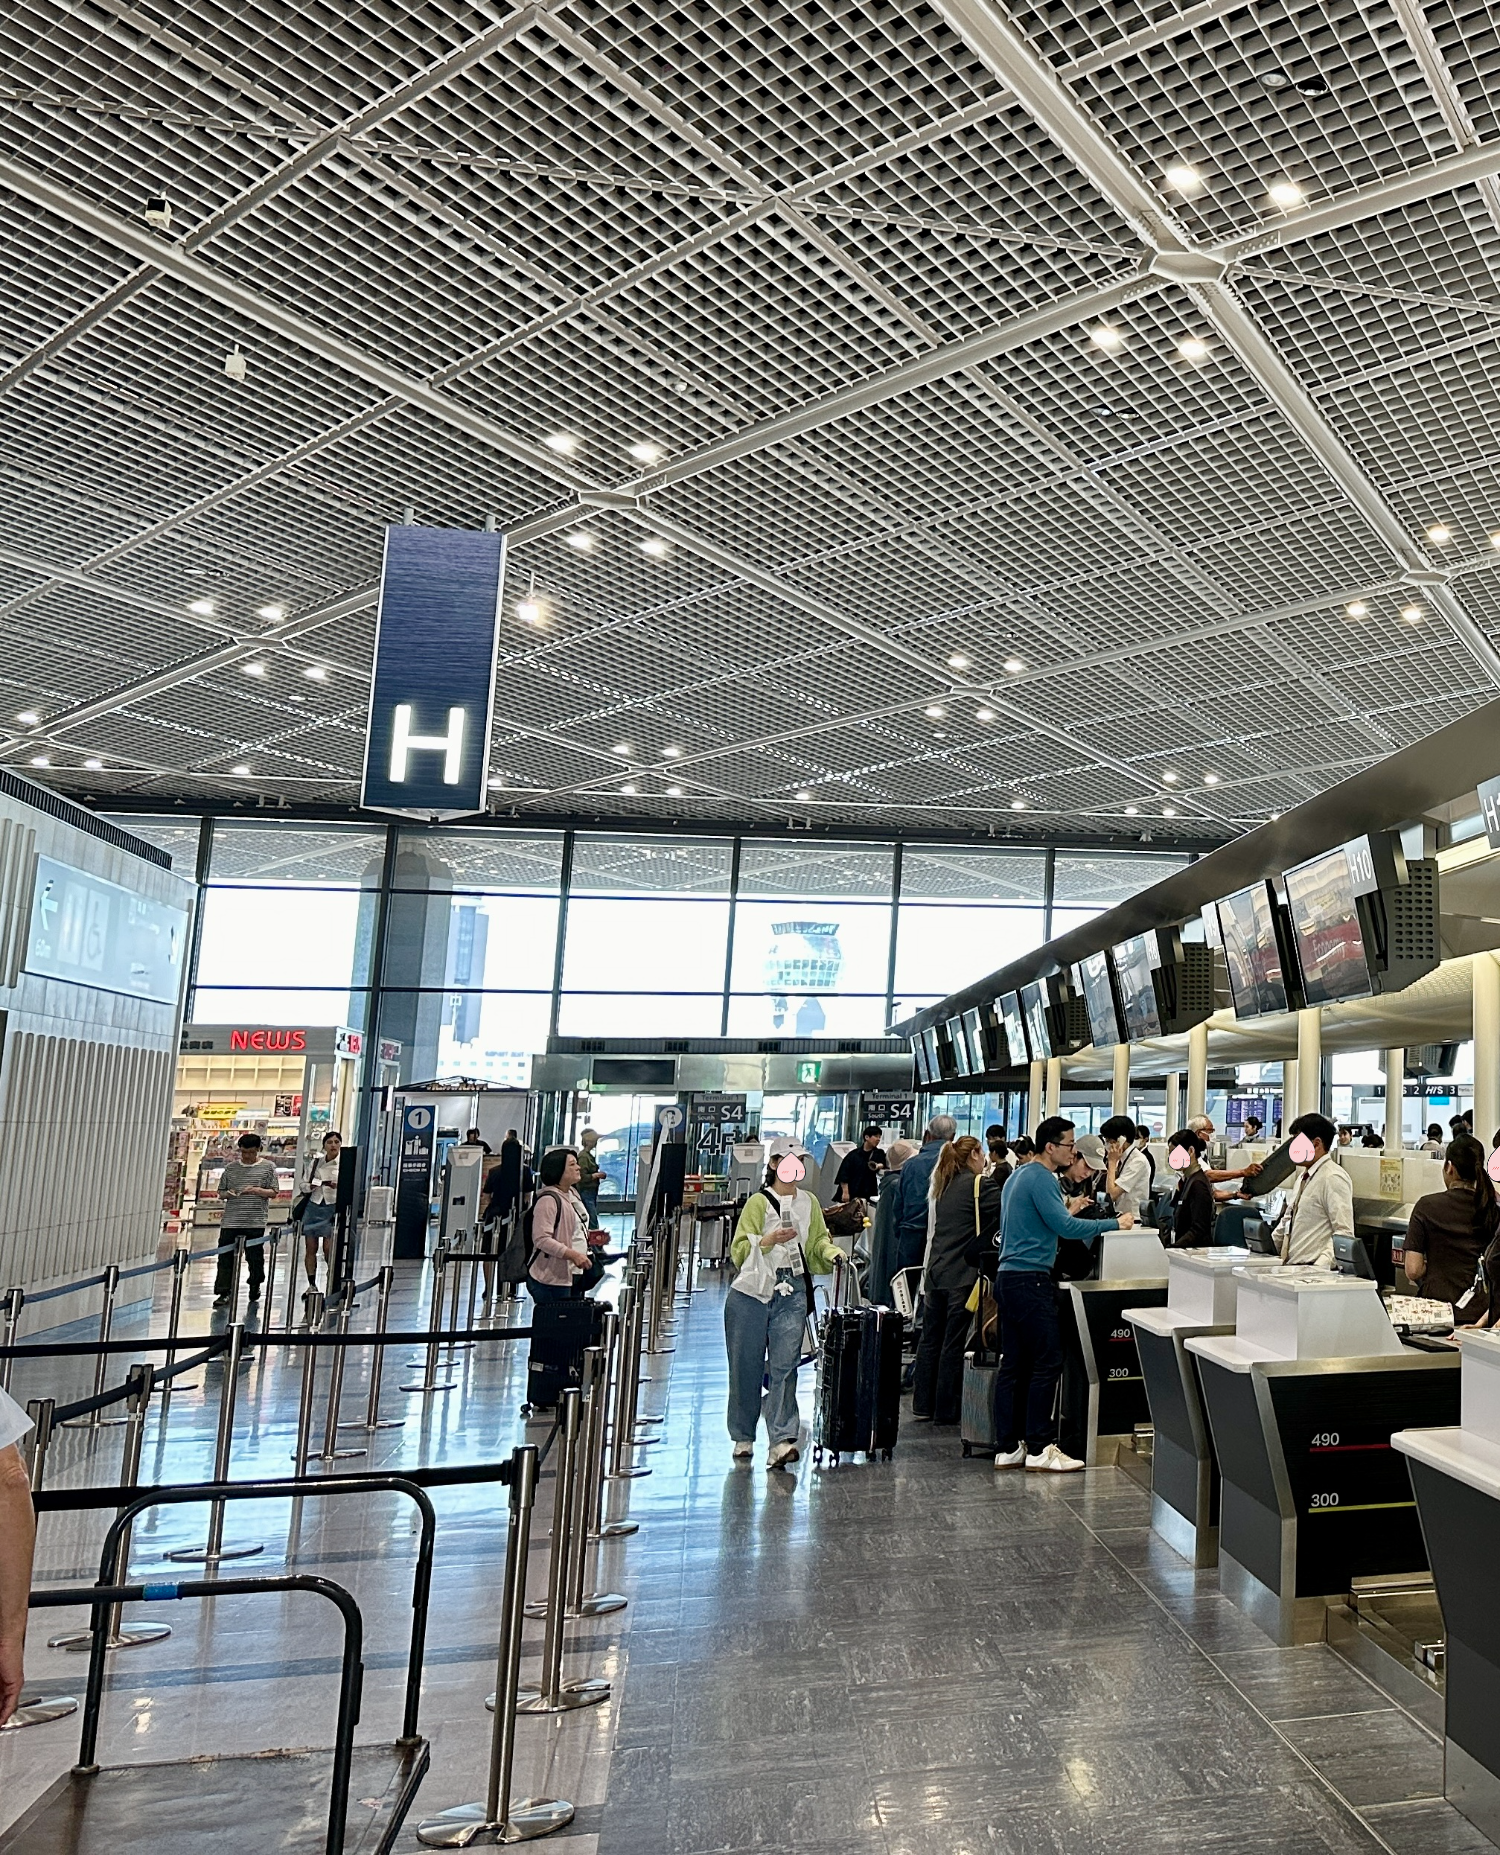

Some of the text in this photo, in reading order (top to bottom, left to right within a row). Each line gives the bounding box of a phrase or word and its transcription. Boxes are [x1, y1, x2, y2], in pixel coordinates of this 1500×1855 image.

[389, 704, 465, 785] H
[1350, 849, 1372, 885] H10
[231, 1029, 306, 1050] NEWS
[1413, 1086, 1419, 1095] 2
[1449, 1086, 1455, 1094] 3
[415, 1111, 422, 1125] 1
[720, 1105, 743, 1120] S4
[890, 1103, 911, 1119] S4
[697, 1126, 736, 1155] 4F
[1110, 1328, 1130, 1338] 490
[1109, 1367, 1129, 1378] 300
[1311, 1432, 1340, 1446] 490
[1311, 1492, 1339, 1507] 300
